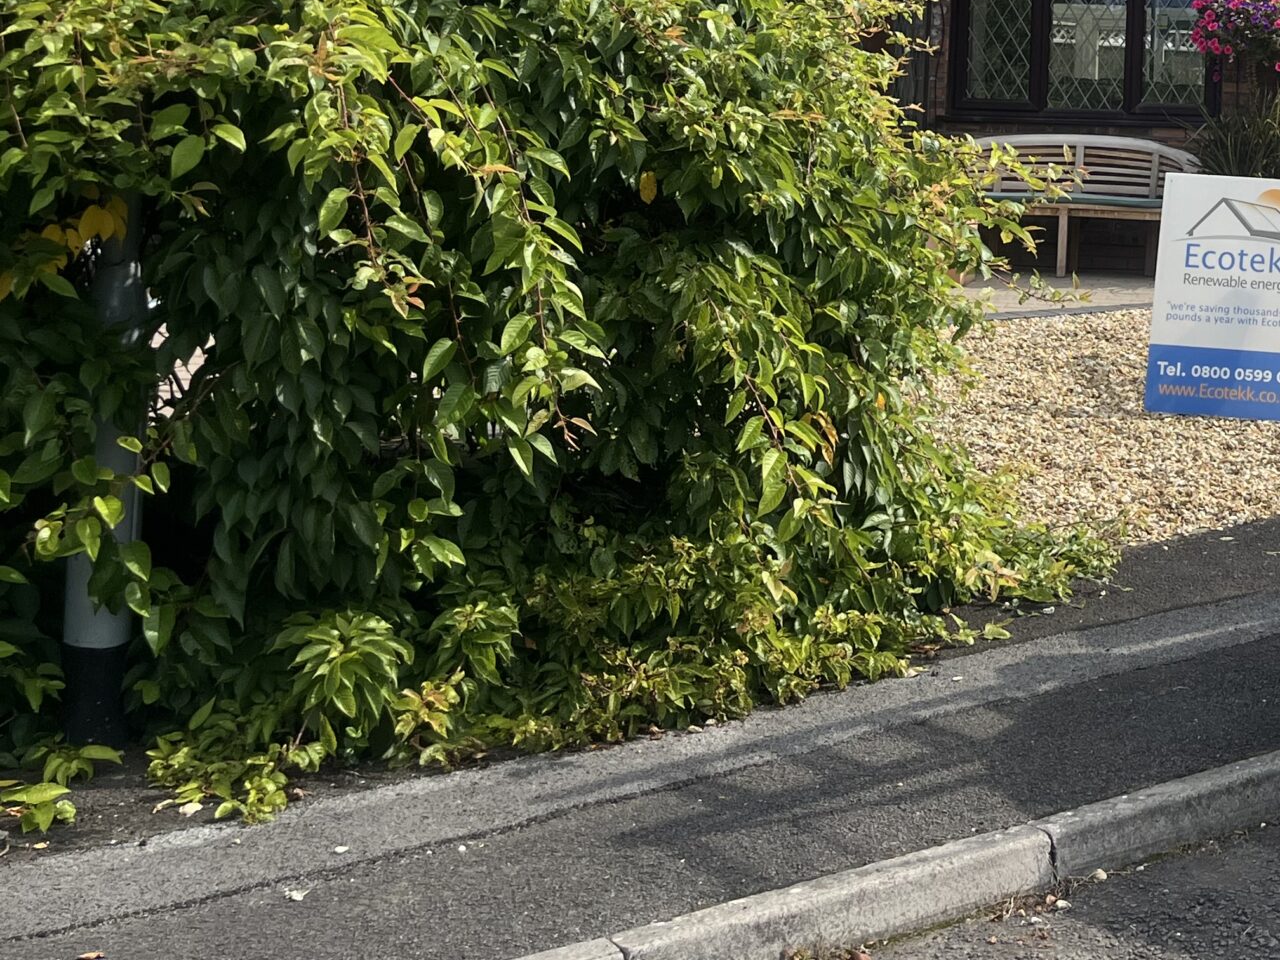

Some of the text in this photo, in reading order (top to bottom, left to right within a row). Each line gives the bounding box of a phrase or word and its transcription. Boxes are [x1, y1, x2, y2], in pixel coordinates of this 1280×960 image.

[1183, 273, 1248, 289] Renewable
[1199, 304, 1231, 315] saving
[1166, 312, 1202, 323] pounds
[1214, 315, 1234, 326] year
[1237, 315, 1258, 327] with
[1157, 361, 1187, 377] Tel.
[1191, 364, 1231, 380] 0800
[1235, 366, 1273, 382] 0599
